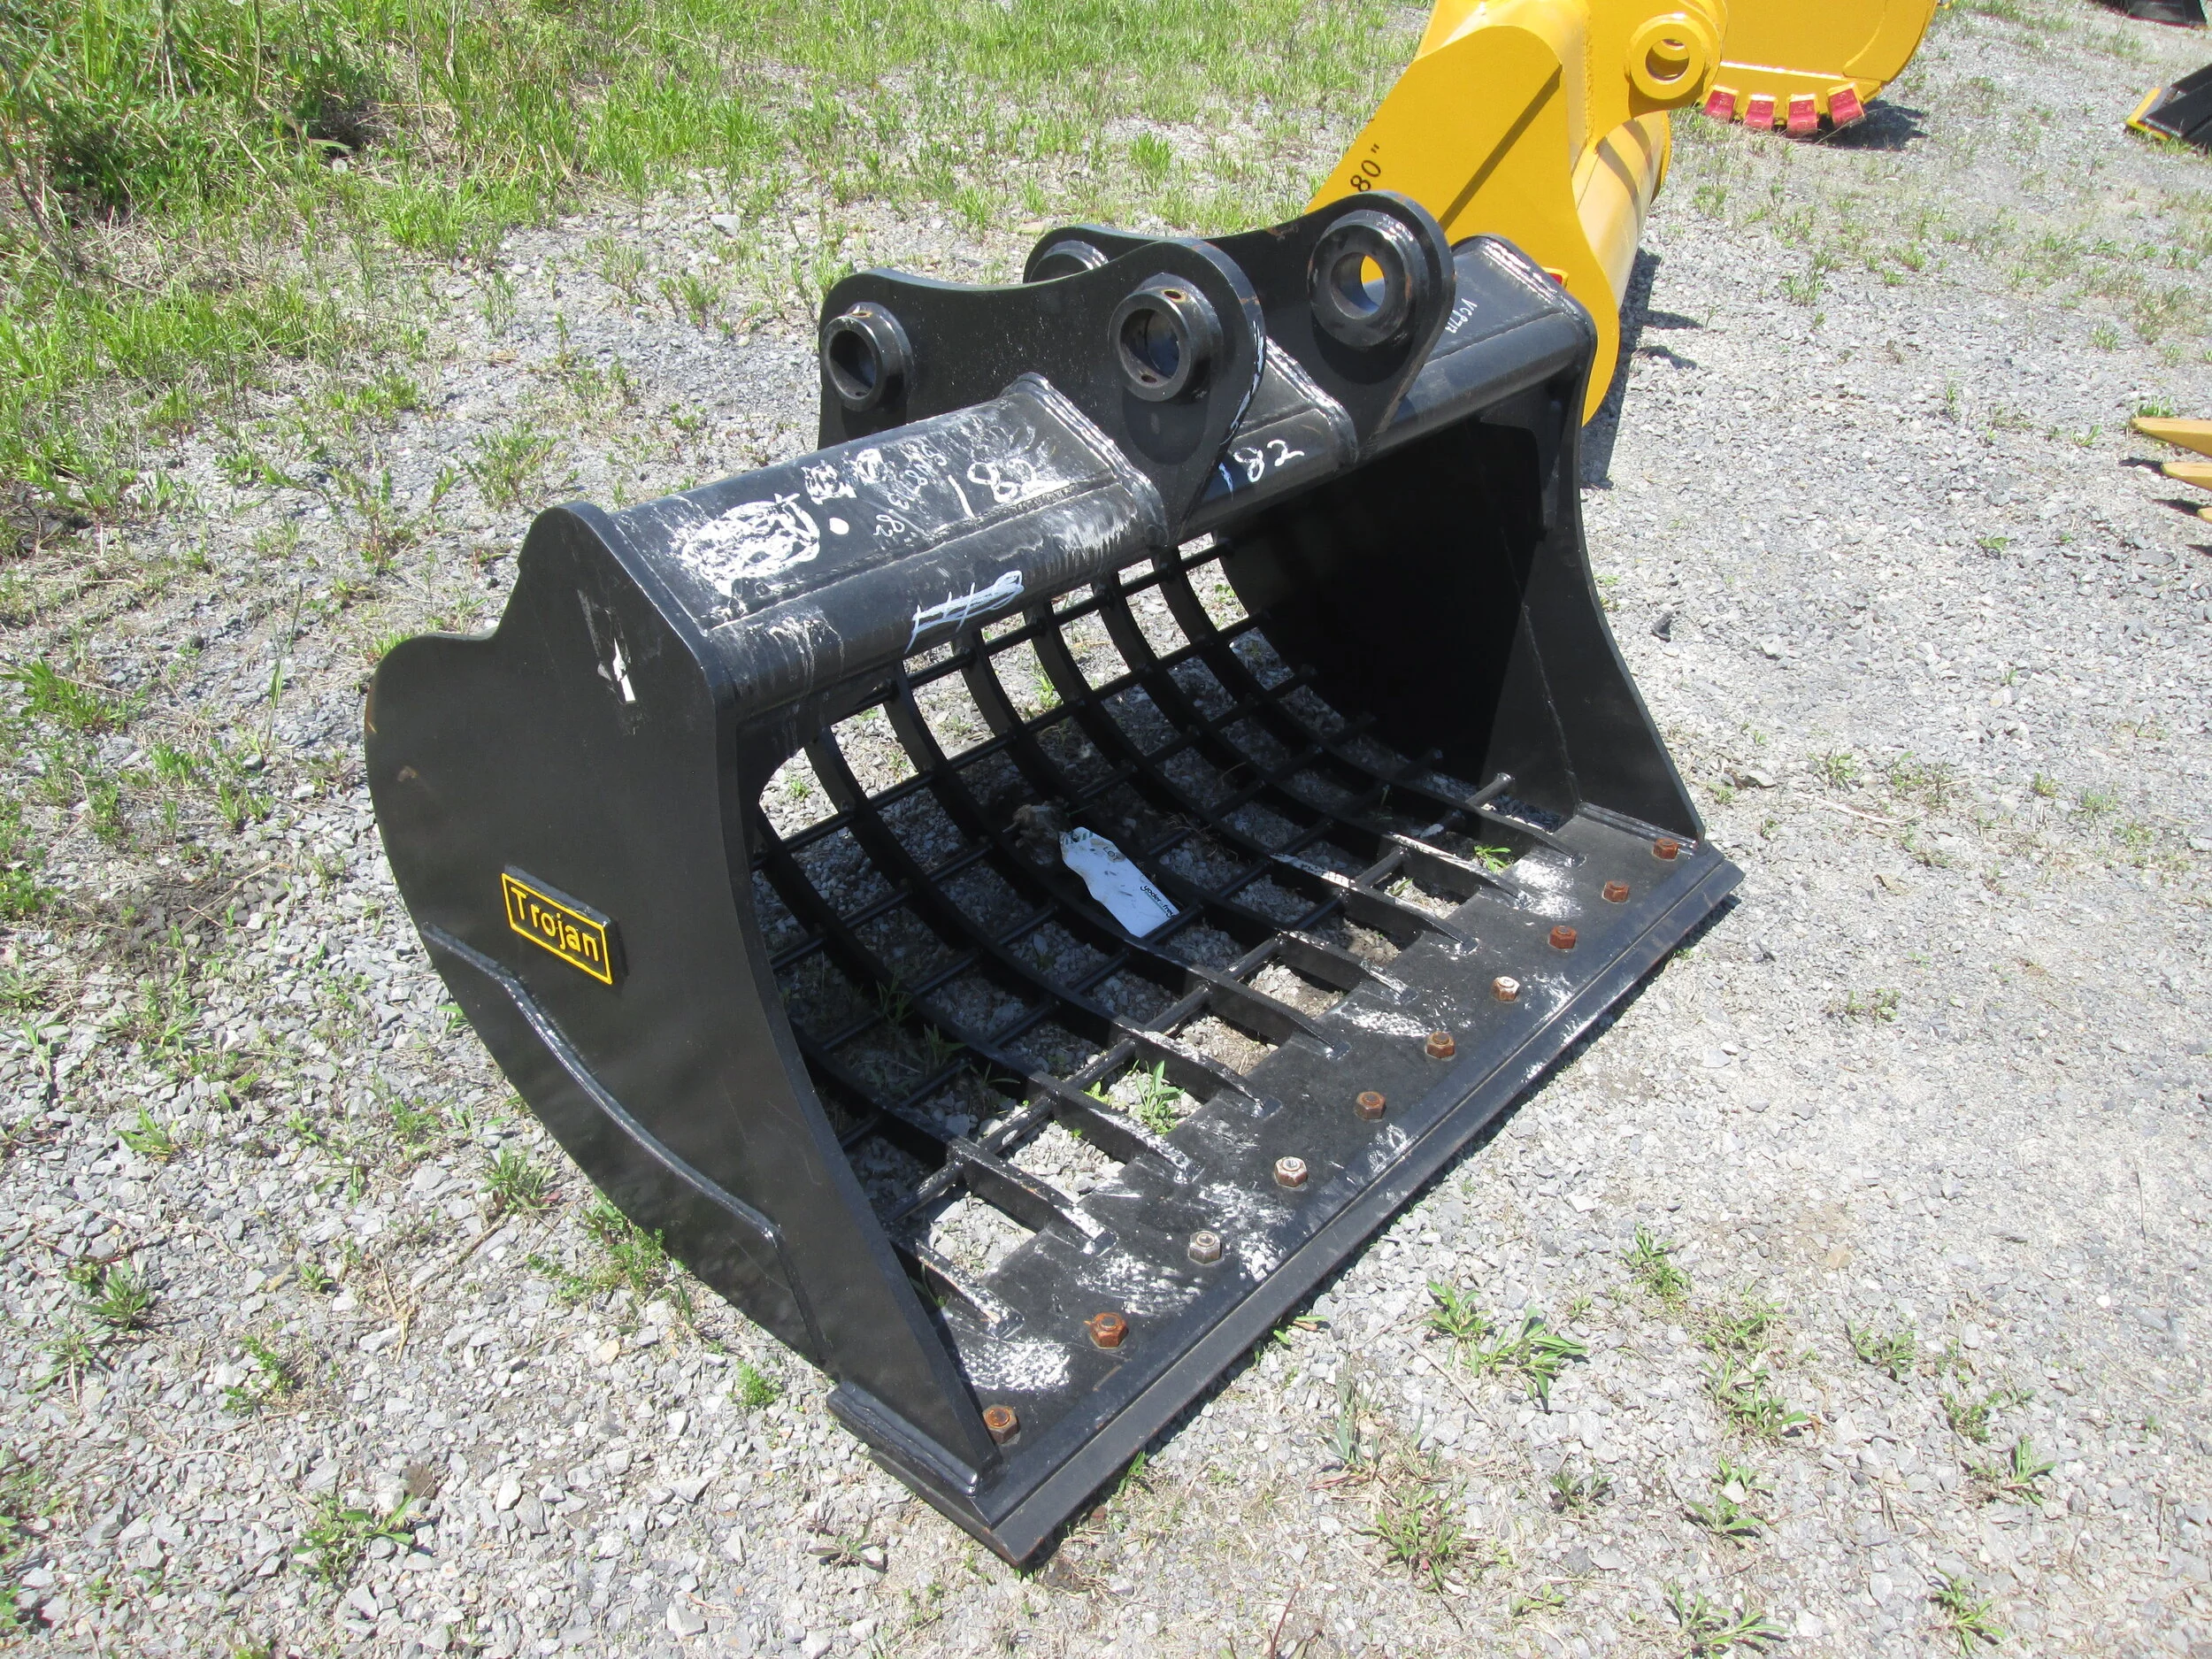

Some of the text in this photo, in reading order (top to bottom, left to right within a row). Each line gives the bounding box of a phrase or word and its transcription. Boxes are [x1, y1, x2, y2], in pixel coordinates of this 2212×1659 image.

[1350, 142, 1381, 192] 80"
[947, 457, 1071, 518] 182
[1102, 846, 1121, 861] LOT
[511, 887, 599, 962] Trojan
[1140, 885, 1177, 918] yoder frey
